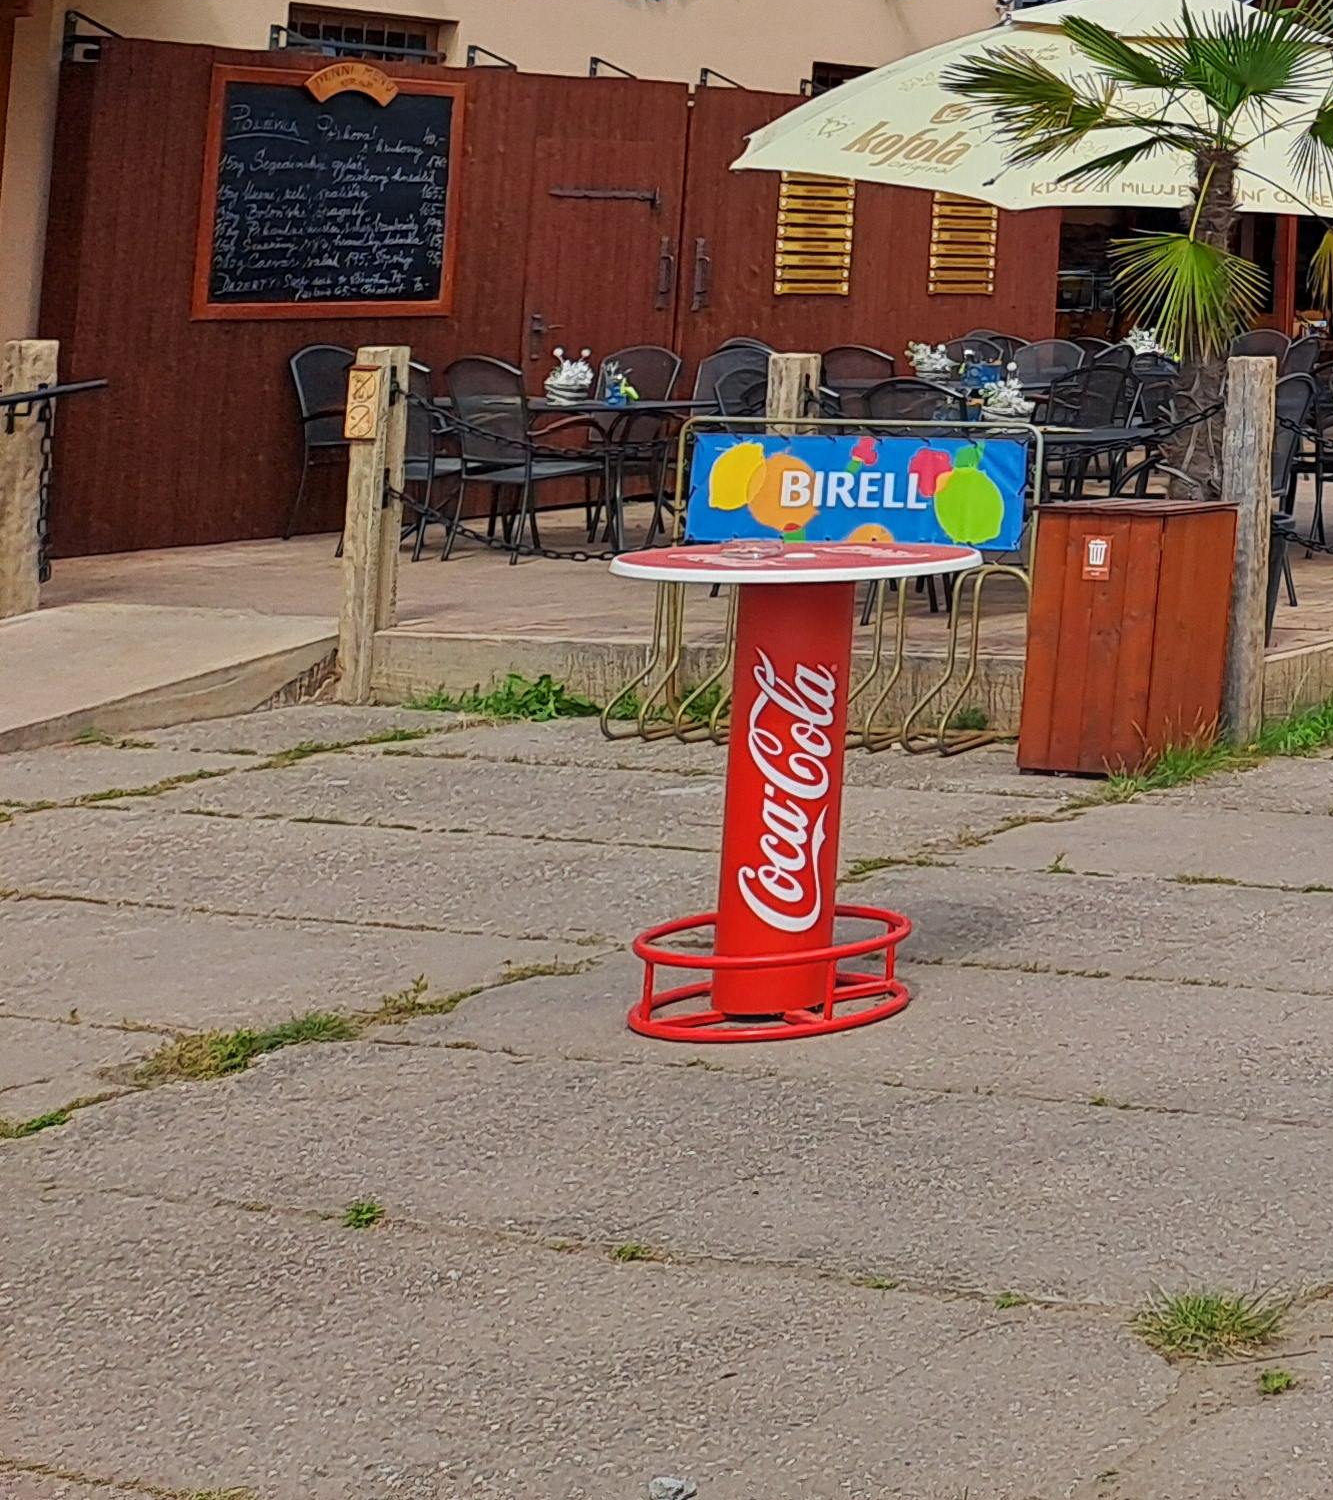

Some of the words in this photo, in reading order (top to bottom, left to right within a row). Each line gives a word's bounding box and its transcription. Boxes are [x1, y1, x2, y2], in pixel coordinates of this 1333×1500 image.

[841, 121, 973, 167] kofola
[887, 161, 963, 176] original
[1121, 182, 1194, 198] MILUJE
[780, 470, 928, 509] BIRELL
[738, 646, 838, 932] Coca-Cola
